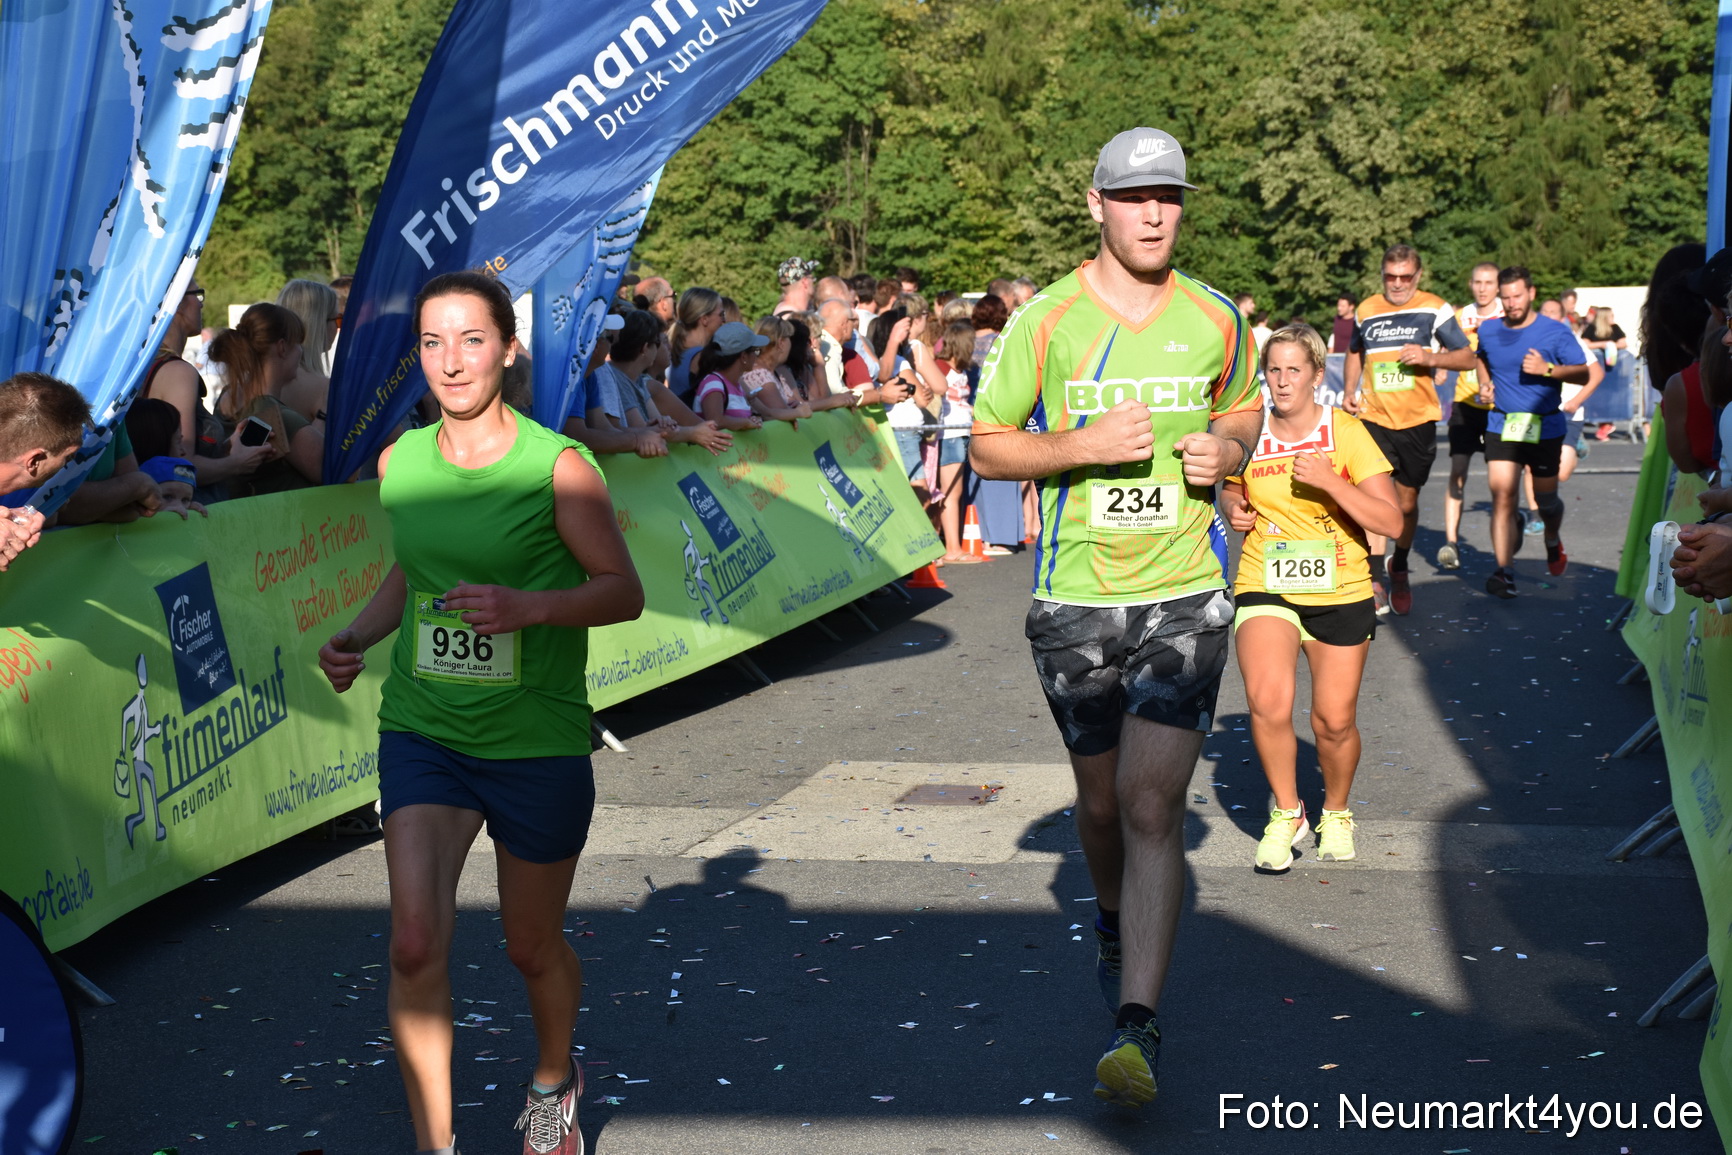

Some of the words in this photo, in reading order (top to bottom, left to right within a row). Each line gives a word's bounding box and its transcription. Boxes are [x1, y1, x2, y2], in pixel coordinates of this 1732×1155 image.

[594, 70, 670, 140] Druck
[668, 19, 719, 74] und
[400, 0, 699, 270] Frischmann
[1135, 138, 1167, 154] NIKE
[1373, 326, 1419, 338] Fischer
[1382, 372, 1405, 384] 570
[1064, 376, 1211, 415] BOCK
[1251, 463, 1288, 479] MAX
[1107, 487, 1163, 513] 234
[255, 522, 319, 593] Gesunde
[319, 514, 370, 559] Firmen
[709, 517, 776, 598] firmenlauf
[1272, 559, 1326, 578] 1268
[292, 578, 339, 635] laufen
[337, 544, 385, 609] länger!
[178, 609, 213, 643] Fischer
[186, 630, 215, 655] AUTOMOBILE
[432, 626, 493, 662] 936
[433, 658, 466, 671] Königer
[467, 662, 492, 672] Laura
[440, 668, 468, 676] Landkreises
[162, 645, 288, 792] firmenlauf
[172, 764, 233, 826] neumarkt
